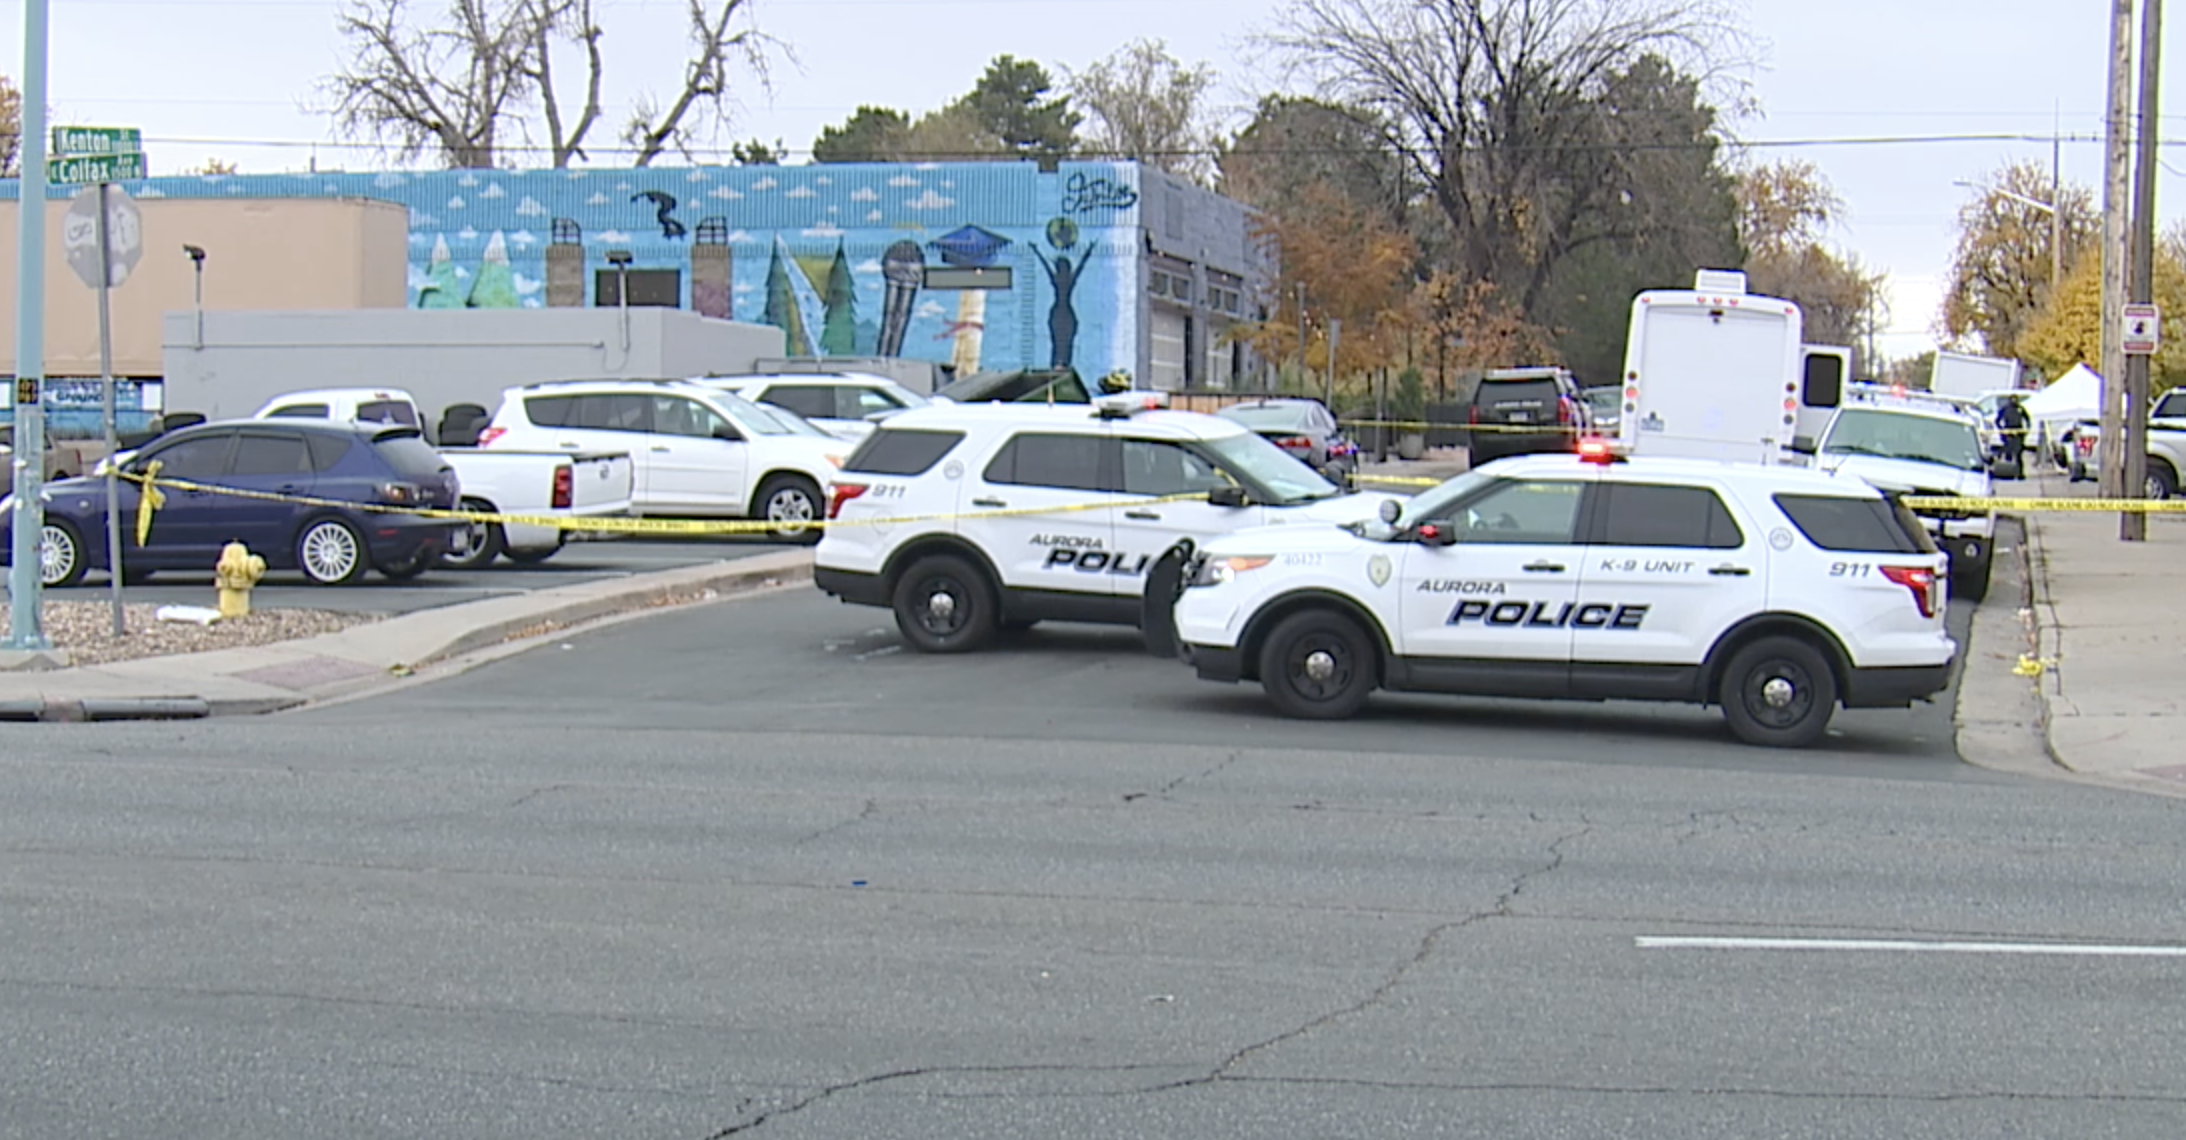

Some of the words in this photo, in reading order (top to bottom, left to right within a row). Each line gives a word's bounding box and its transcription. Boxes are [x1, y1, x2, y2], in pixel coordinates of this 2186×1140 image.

[61, 129, 111, 151] Kenton
[60, 158, 110, 183] Colfax
[872, 484, 906, 499] 911
[1029, 534, 1104, 549] AURORA
[1042, 549, 1150, 576] POLI
[1601, 560, 1637, 571] K-9
[1644, 561, 1696, 573] UNIT
[1829, 562, 1871, 577] 911
[1416, 580, 1506, 594] AURORA
[1446, 599, 1651, 629] POLICE
